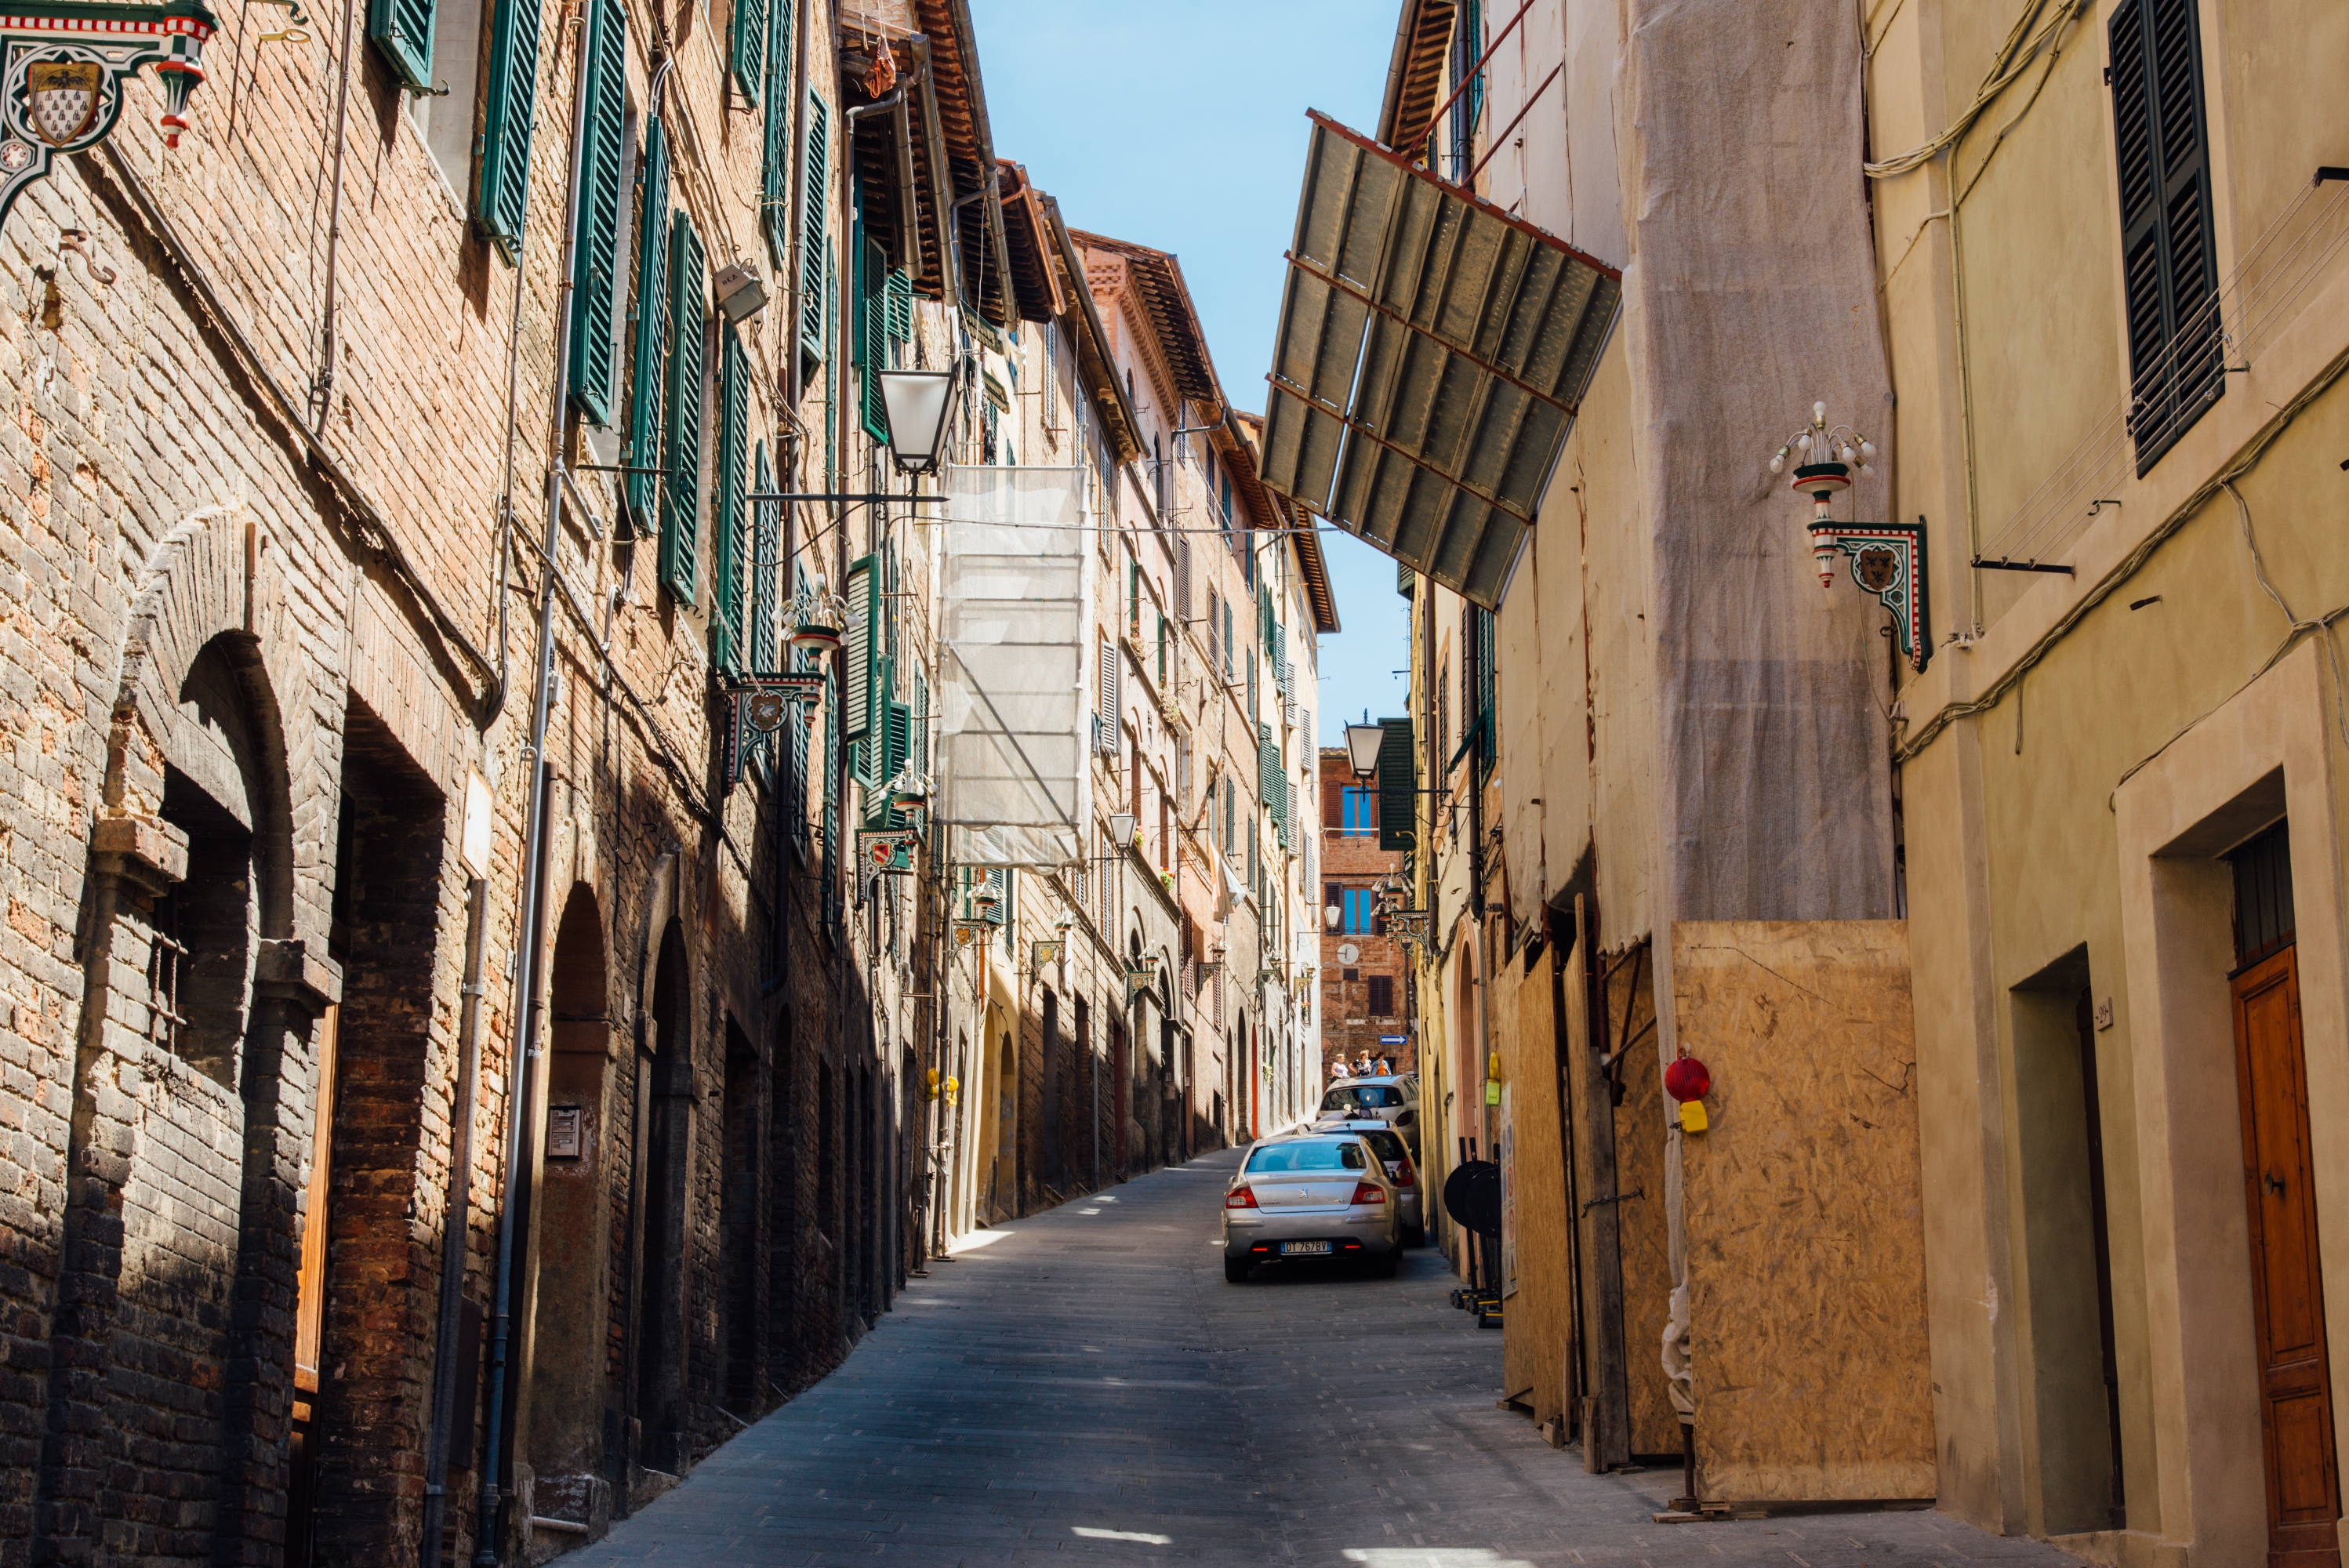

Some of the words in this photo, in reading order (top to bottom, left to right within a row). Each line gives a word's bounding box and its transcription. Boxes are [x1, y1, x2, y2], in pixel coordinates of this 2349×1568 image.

[722, 274, 739, 285] OCA
[2099, 1004, 2107, 1024] 29
[1286, 1243, 1297, 1252] DT
[1300, 1242, 1327, 1252] 767BV
